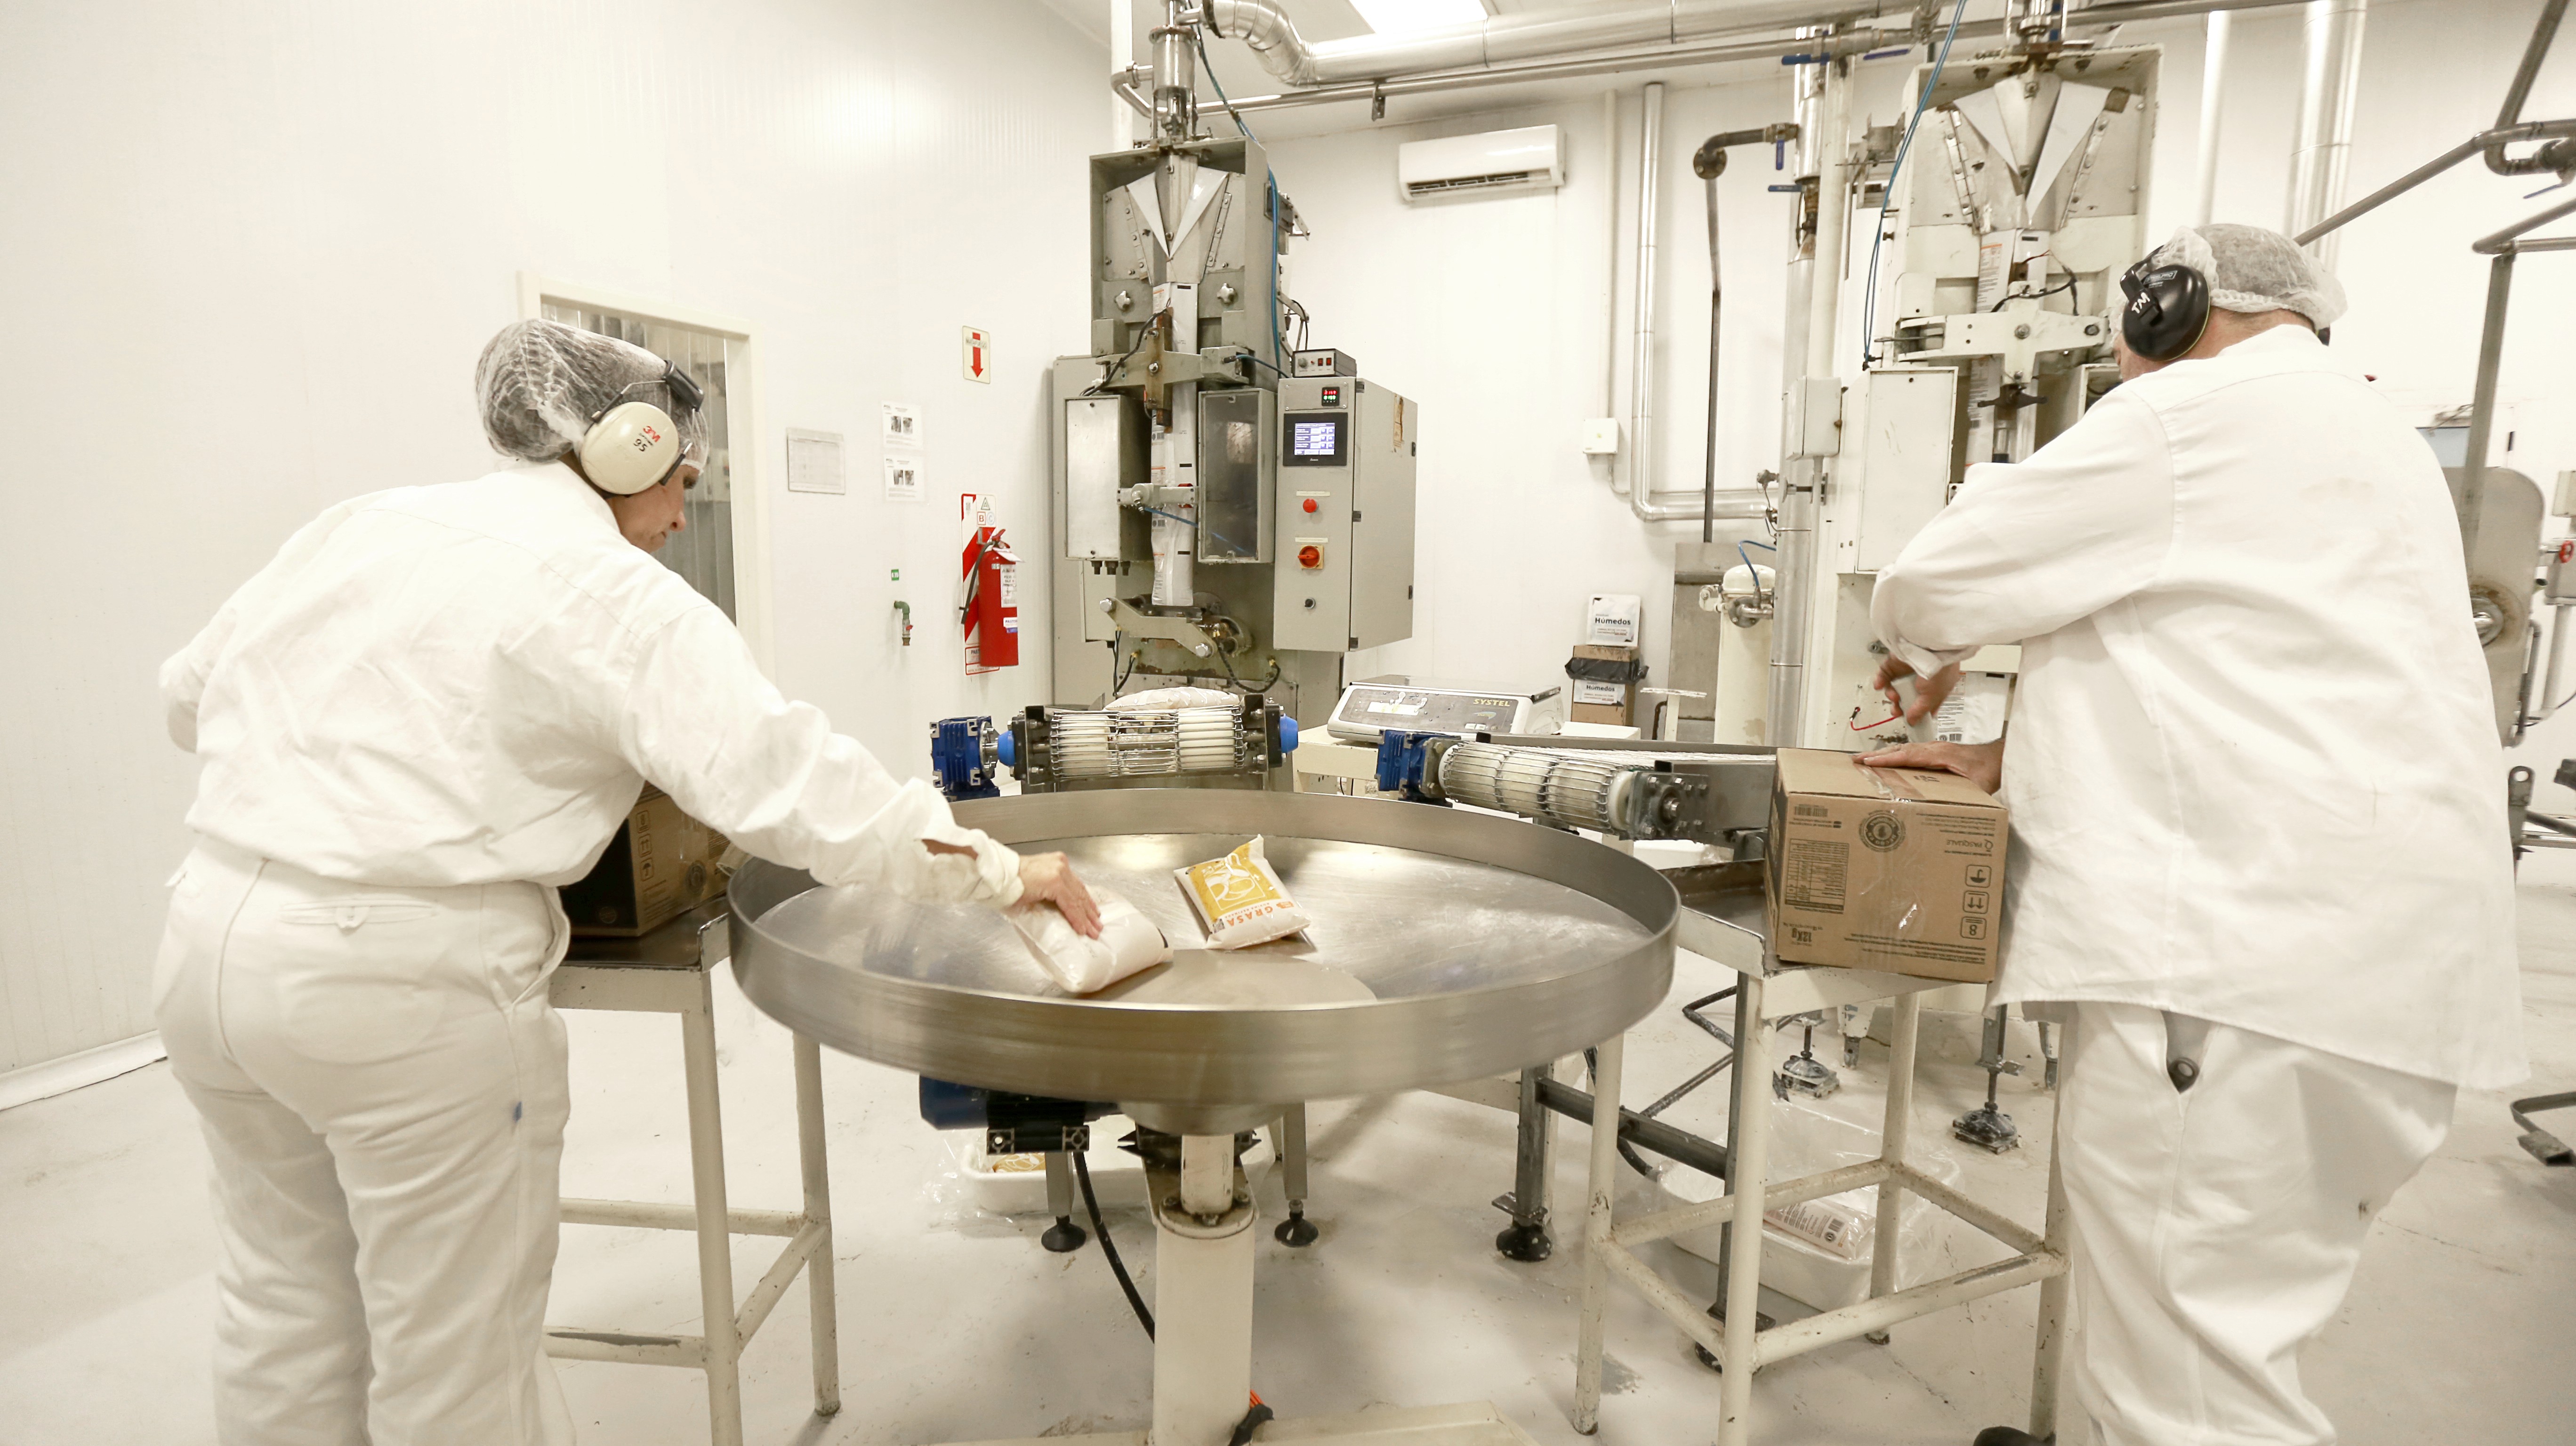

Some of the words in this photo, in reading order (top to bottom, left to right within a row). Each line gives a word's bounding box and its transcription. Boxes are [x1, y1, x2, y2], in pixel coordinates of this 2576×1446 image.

[2131, 292, 2151, 314] TM
[643, 426, 661, 442] 3M
[633, 438, 648, 452] 95
[1594, 617, 1631, 625] Húmedos
[1473, 699, 1511, 707] SYSTEL
[1946, 839, 1982, 848] PASQUALE
[1226, 906, 1273, 927] GRASA
[1969, 924, 1977, 936] 8
